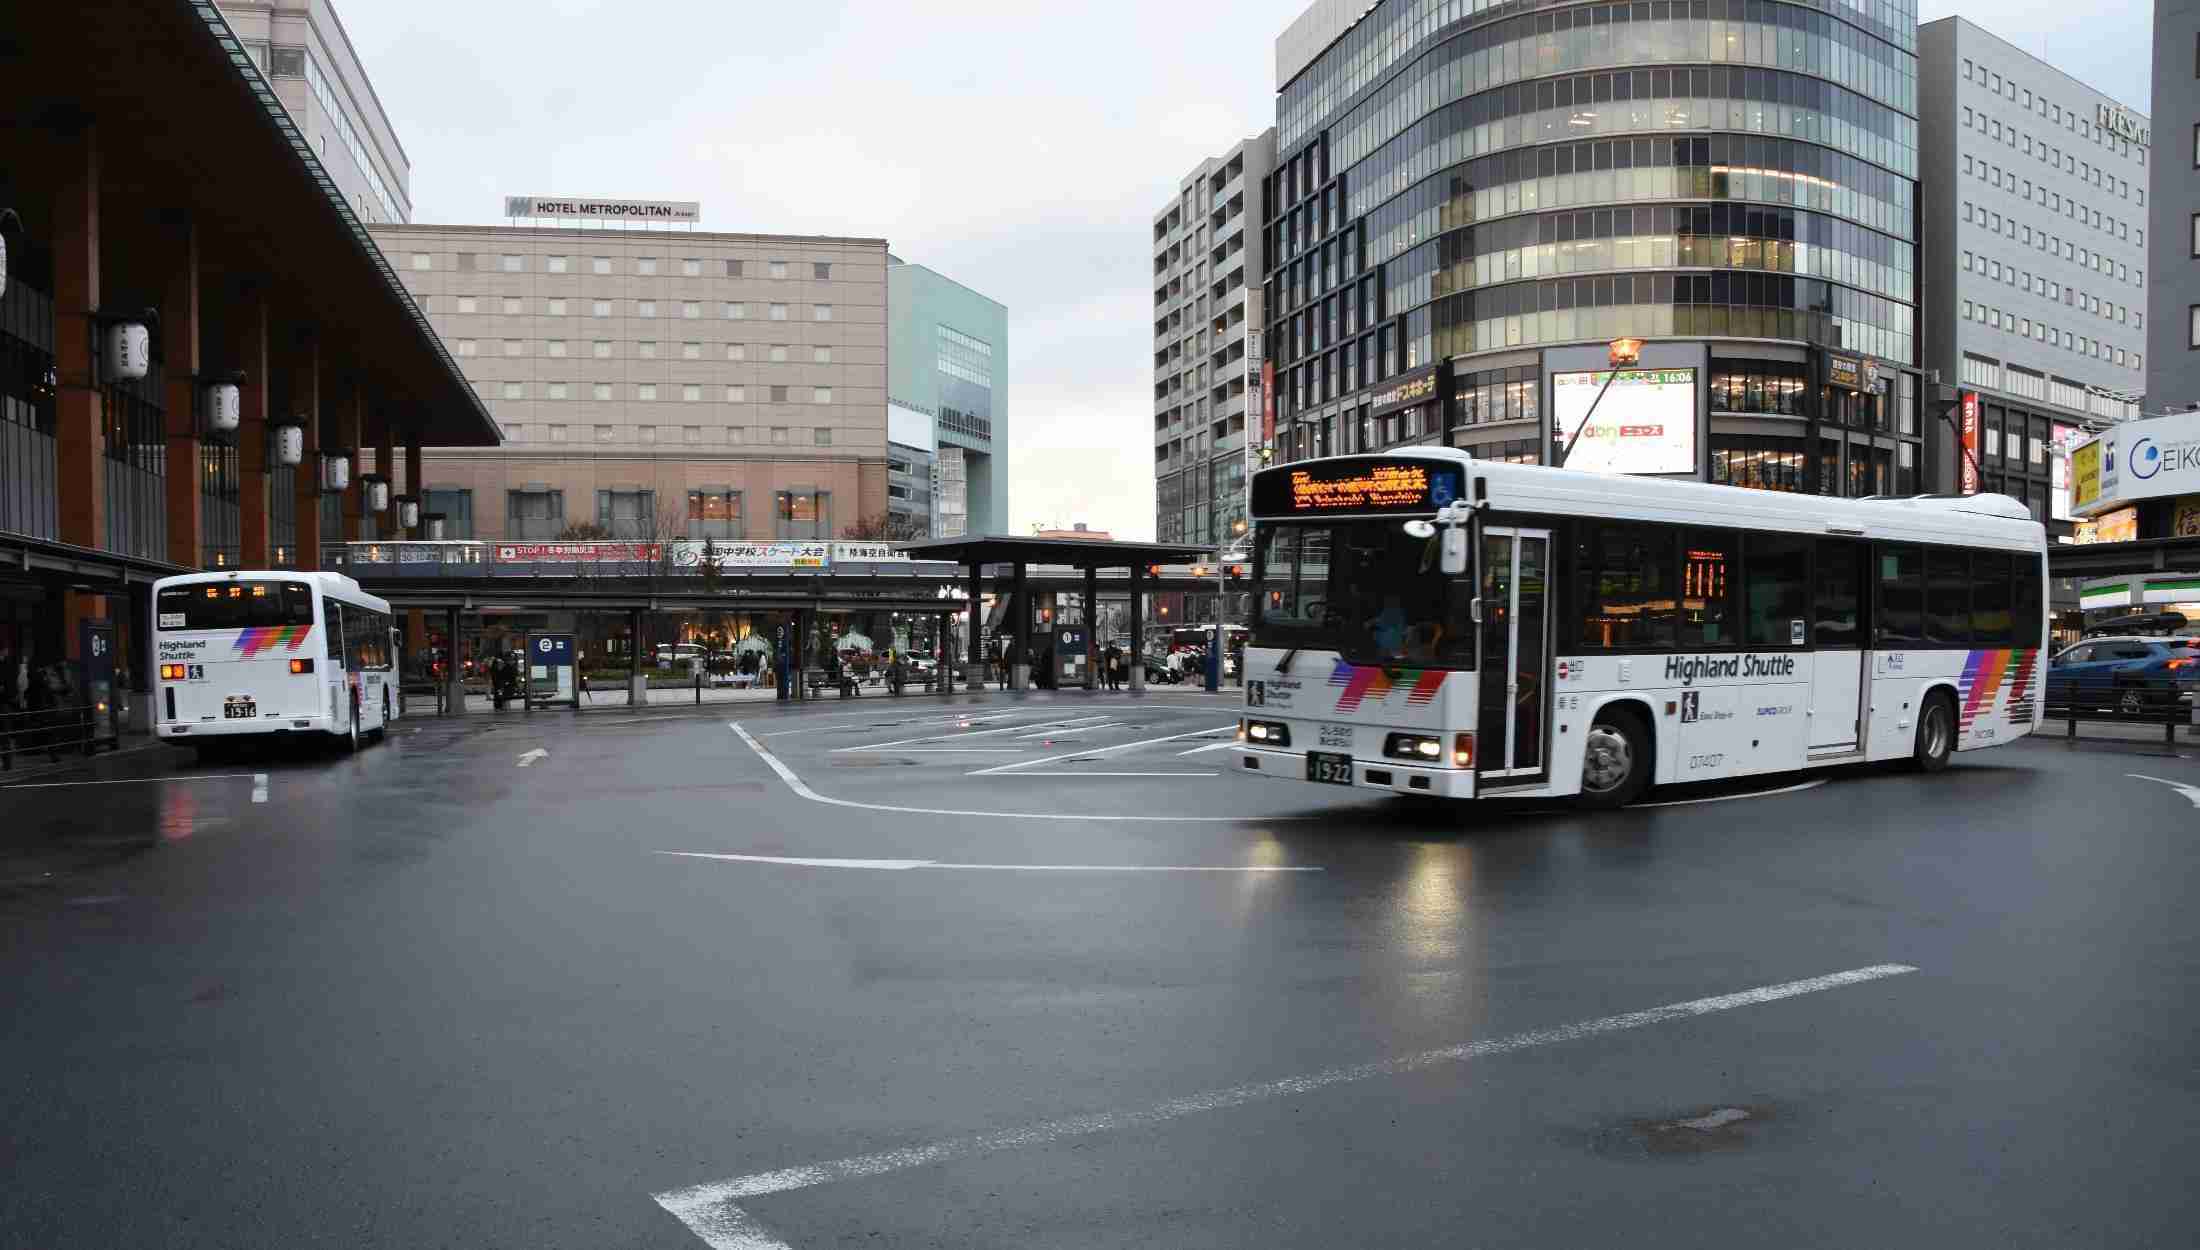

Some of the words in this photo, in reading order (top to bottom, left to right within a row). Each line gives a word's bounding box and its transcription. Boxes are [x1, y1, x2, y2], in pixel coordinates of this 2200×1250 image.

[537, 202, 576, 214] HOTEL
[579, 203, 672, 217] METROPOLITAN
[1663, 372, 1692, 384] 16:06
[159, 640, 206, 651] Highland
[159, 652, 196, 661] Shuttle
[1665, 655, 1739, 685] Highland
[1742, 654, 1794, 677] Shuttle
